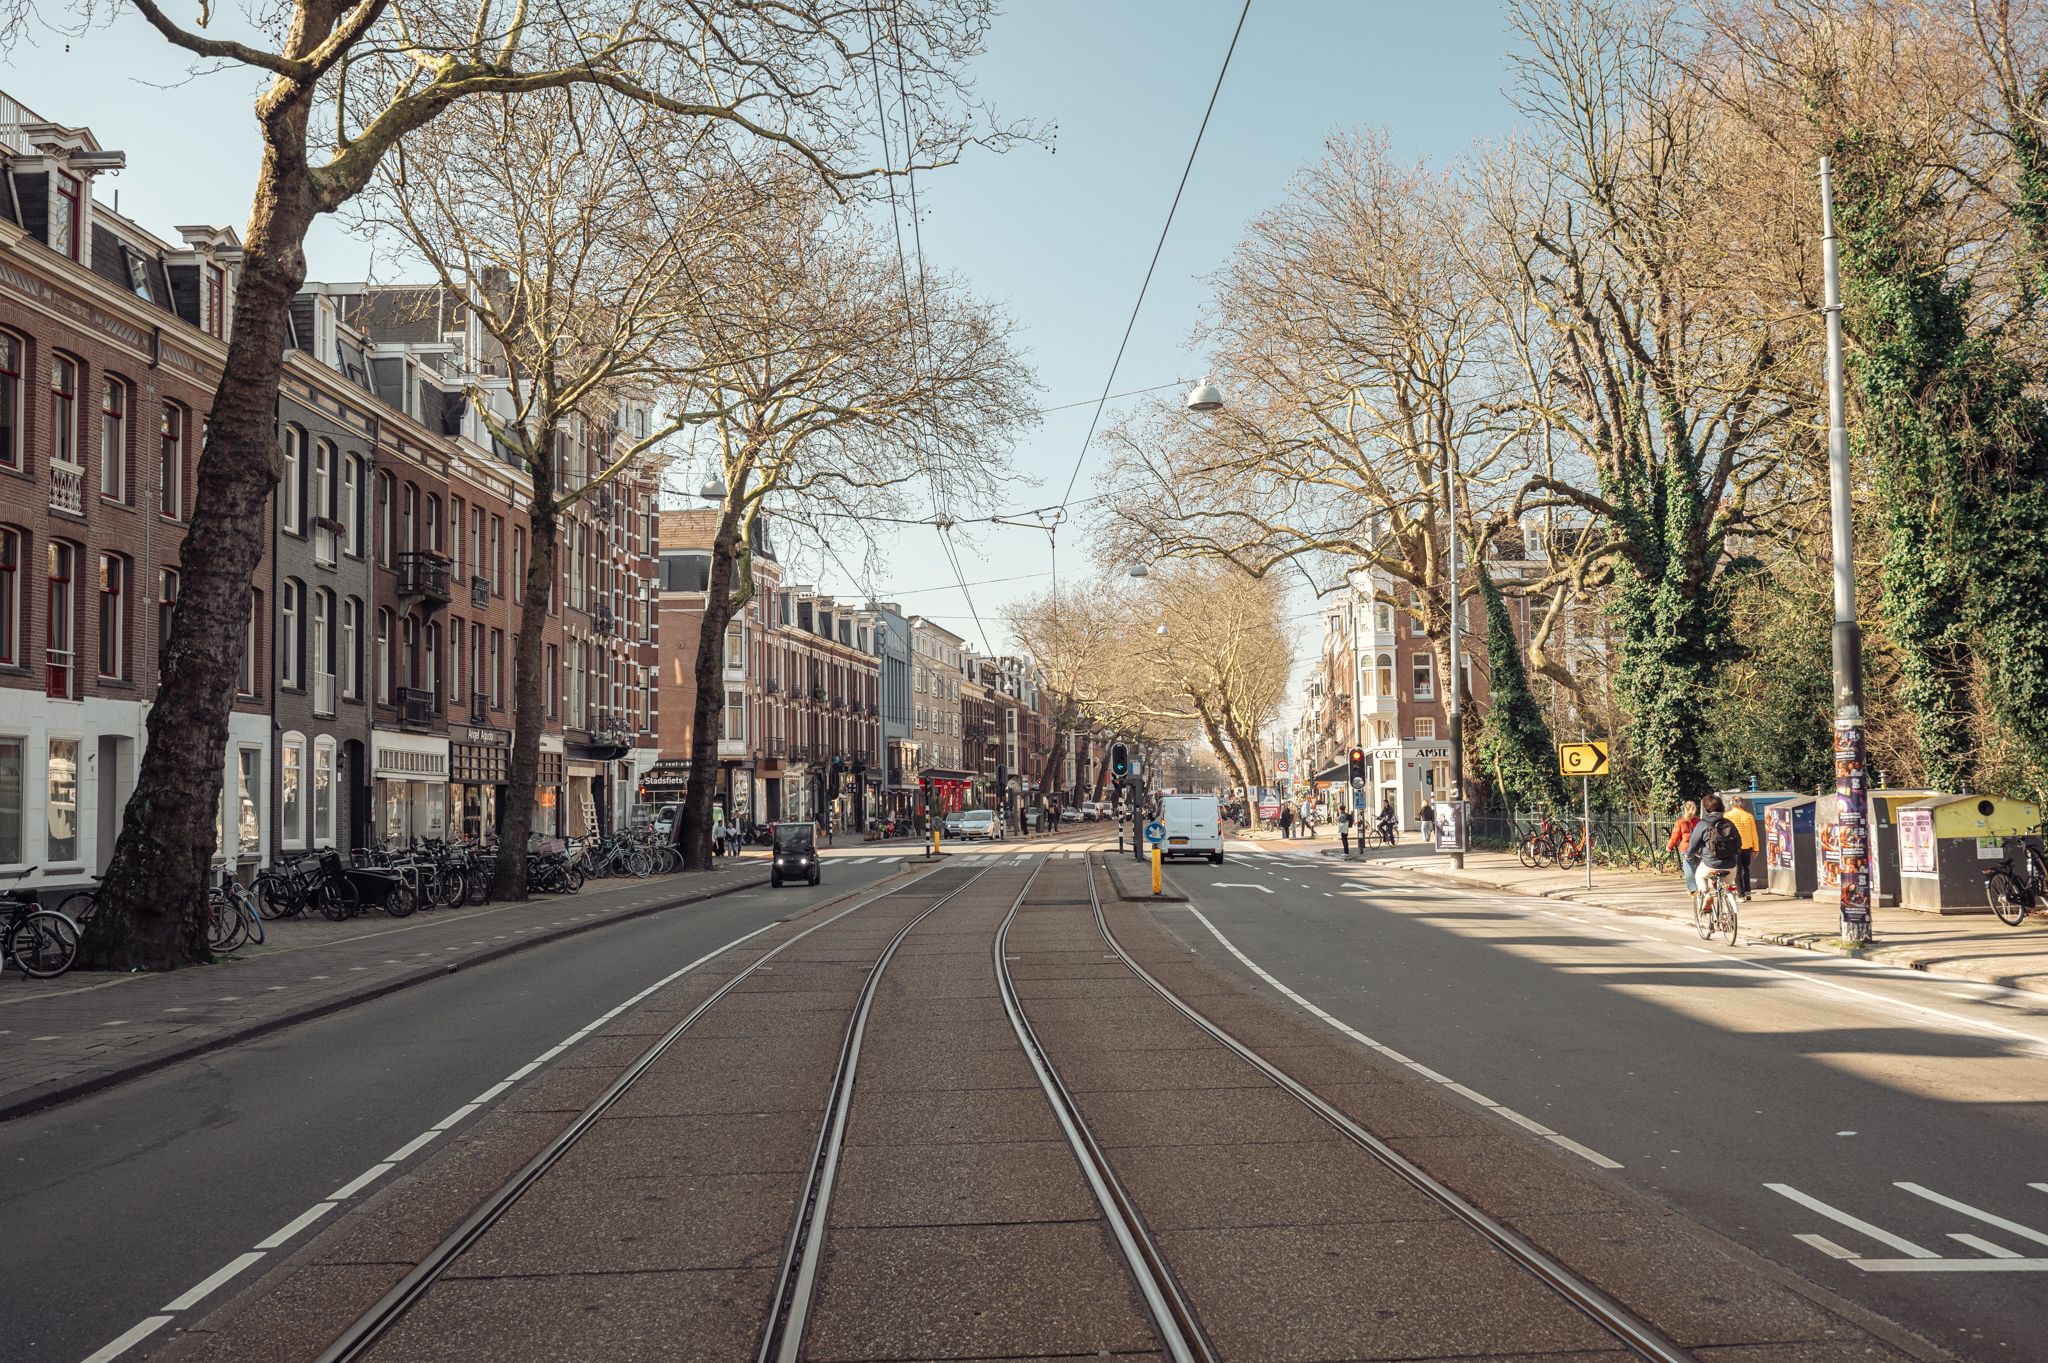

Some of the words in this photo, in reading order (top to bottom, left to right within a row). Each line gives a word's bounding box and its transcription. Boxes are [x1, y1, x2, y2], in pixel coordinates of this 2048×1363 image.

[1415, 748, 1449, 758] AMSTE
[1569, 752, 1581, 766] G
[645, 776, 684, 785] Stadsfiets
